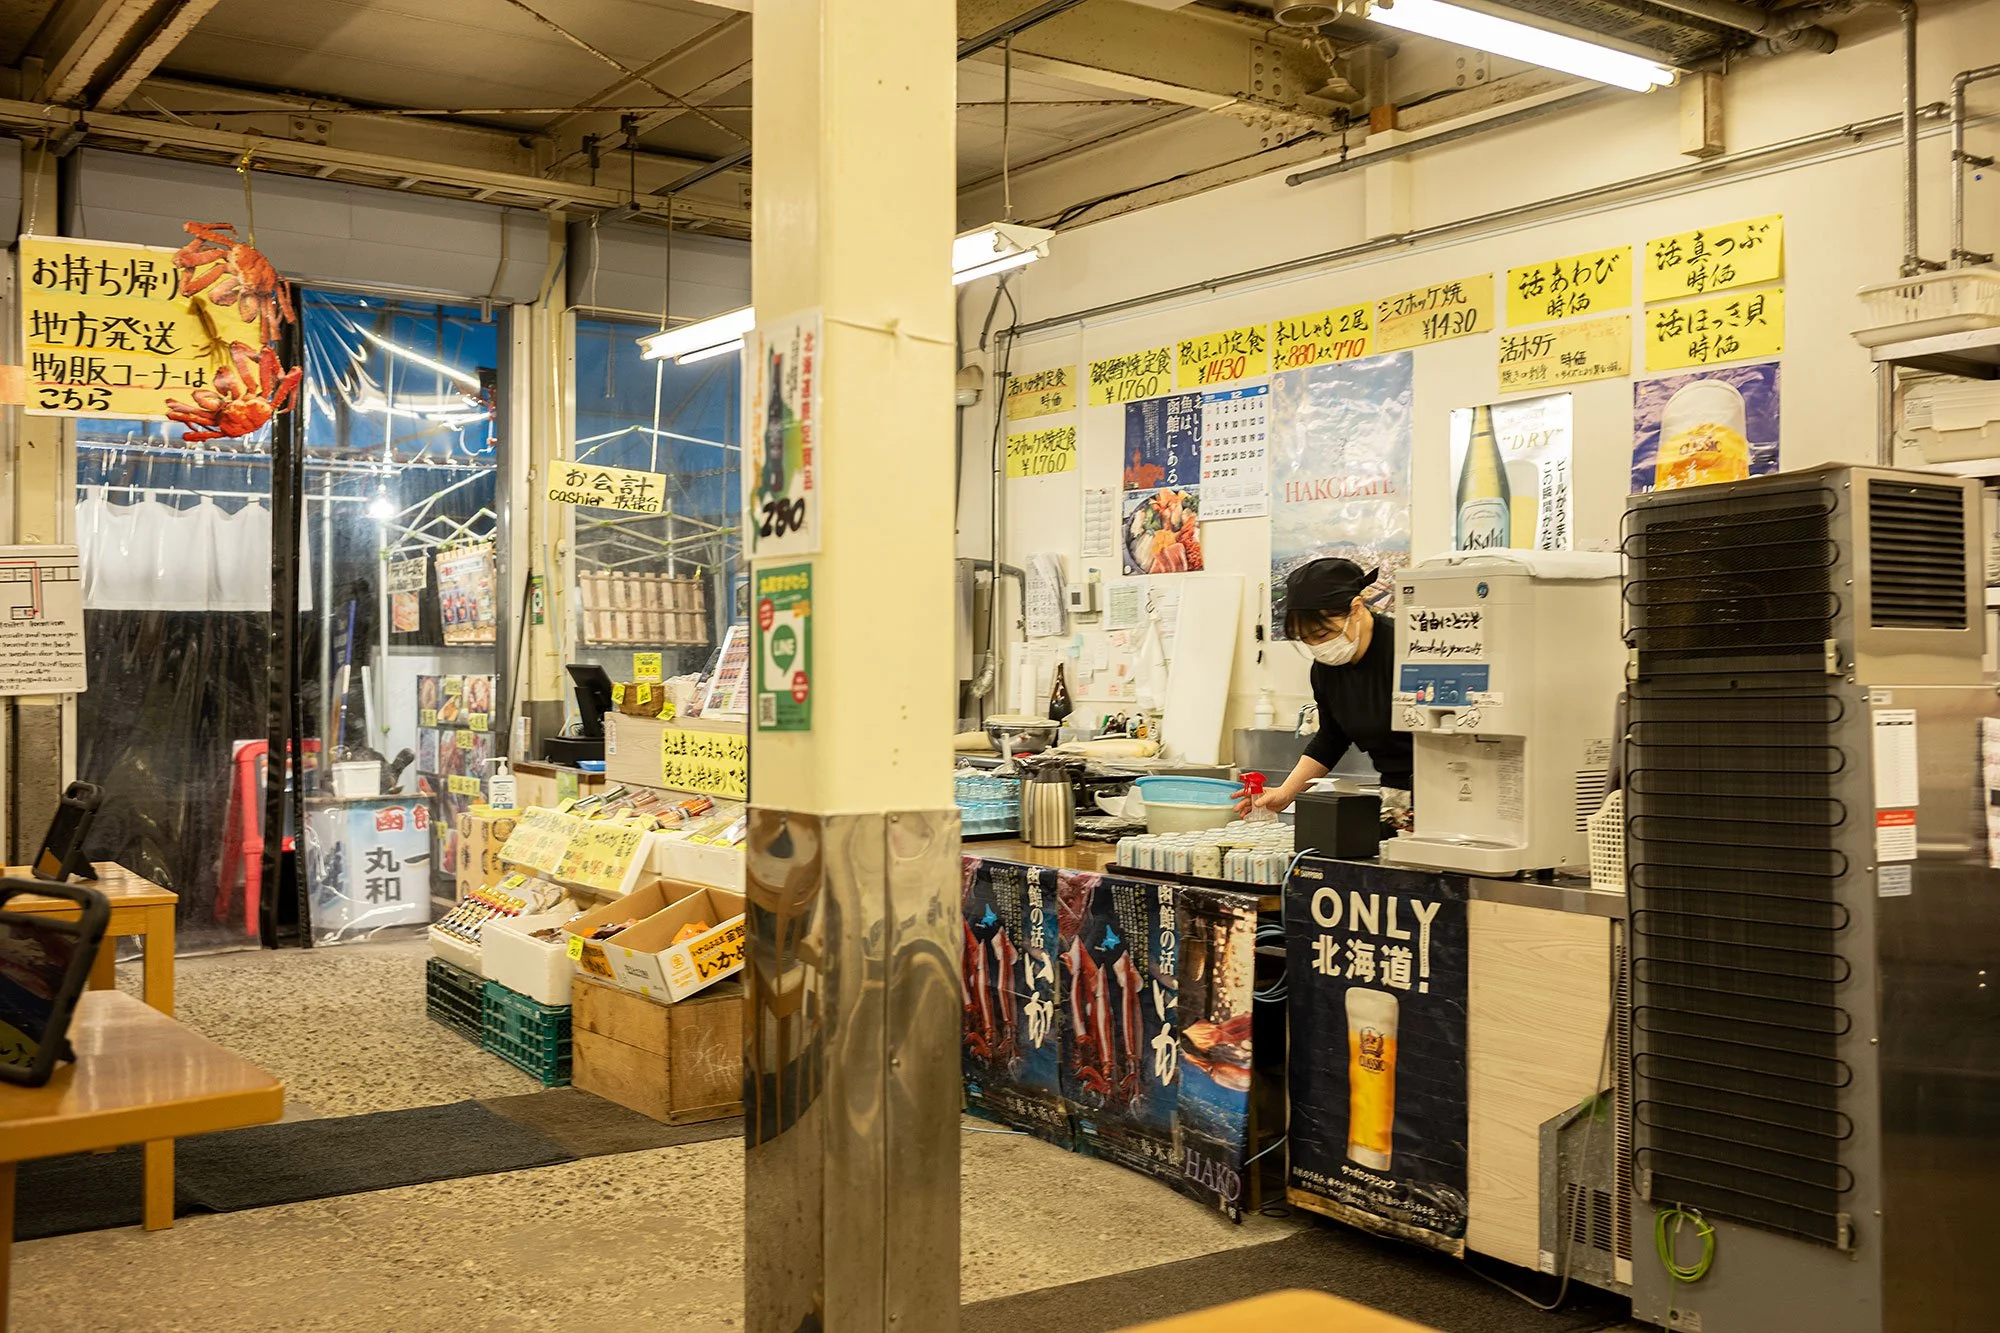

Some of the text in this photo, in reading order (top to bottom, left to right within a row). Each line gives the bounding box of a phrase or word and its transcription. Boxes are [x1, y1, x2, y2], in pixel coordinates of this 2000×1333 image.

[1655, 224, 1771, 271] 活真つぶ
[32, 253, 181, 301] お持ち帰り
[1518, 254, 1620, 300] 活あわび
[1687, 263, 1736, 294] 時価
[1547, 291, 1591, 318] 時価
[1656, 294, 1768, 342] 活ほっき貝
[29, 309, 182, 355] 地方発送
[1274, 315, 1333, 346] 本ししゃも
[1333, 338, 1366, 361] 770
[1500, 333, 1557, 364] 活ホタテ
[1687, 334, 1740, 363] 時価
[32, 352, 208, 390] 物販コーナーは
[1560, 350, 1587, 367] 時価
[39, 388, 113, 411] こちら
[1106, 376, 1158, 404] ¥1,760
[1166, 397, 1180, 484] 函館にある
[566, 469, 654, 497] お会計
[1022, 452, 1067, 476] ¥1,760
[549, 489, 604, 507] cashier
[761, 498, 805, 538] 280
[773, 639, 795, 656] LINE
[364, 847, 401, 905] 丸和
[1026, 867, 1045, 950] 函館の活
[1311, 887, 1441, 962] ONLY
[1158, 884, 1175, 976] 函館の活
[1023, 951, 1054, 1050] いか
[1184, 1147, 1241, 1202] HAKO
